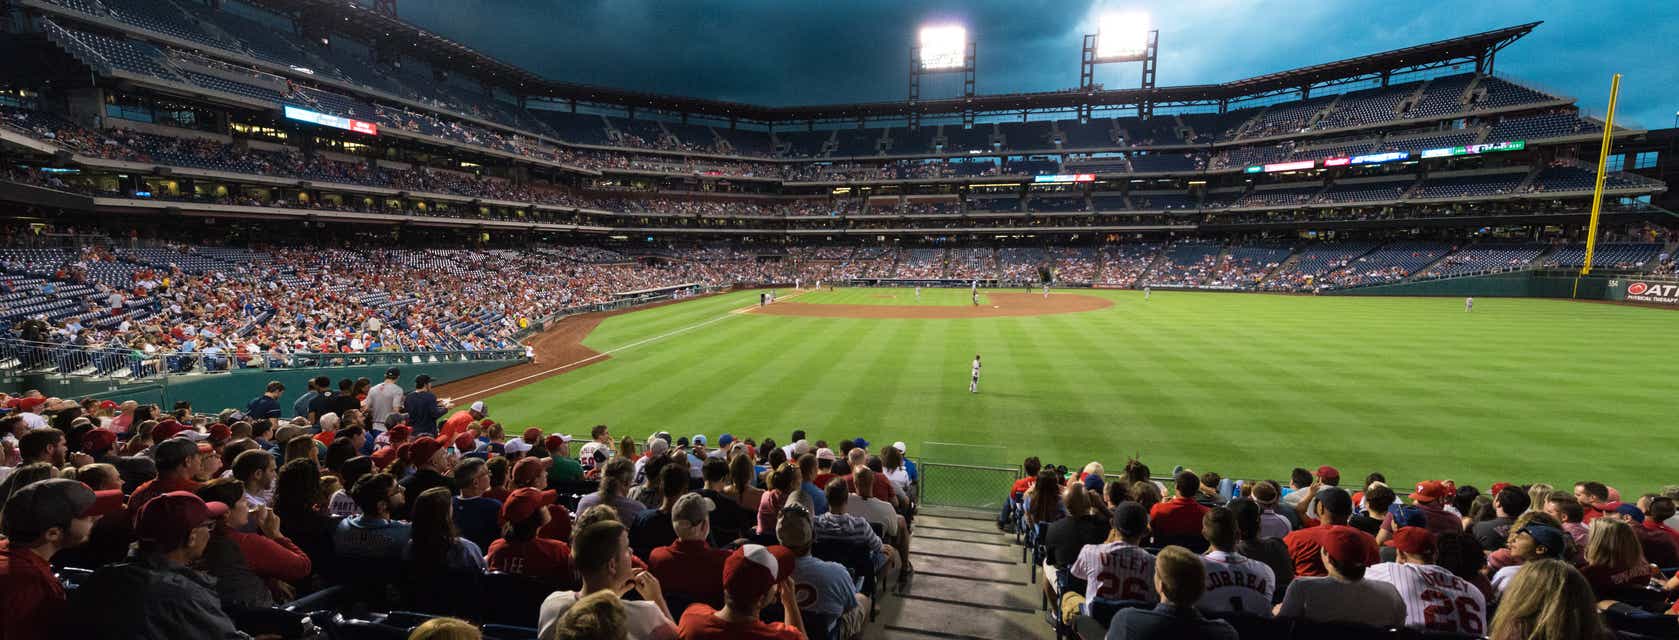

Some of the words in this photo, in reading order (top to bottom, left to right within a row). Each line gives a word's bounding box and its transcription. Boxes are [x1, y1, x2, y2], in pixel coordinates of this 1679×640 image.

[1100, 552, 1147, 574] UTLEY
[1421, 571, 1468, 592] UTLEY
[1421, 589, 1483, 634] 26
